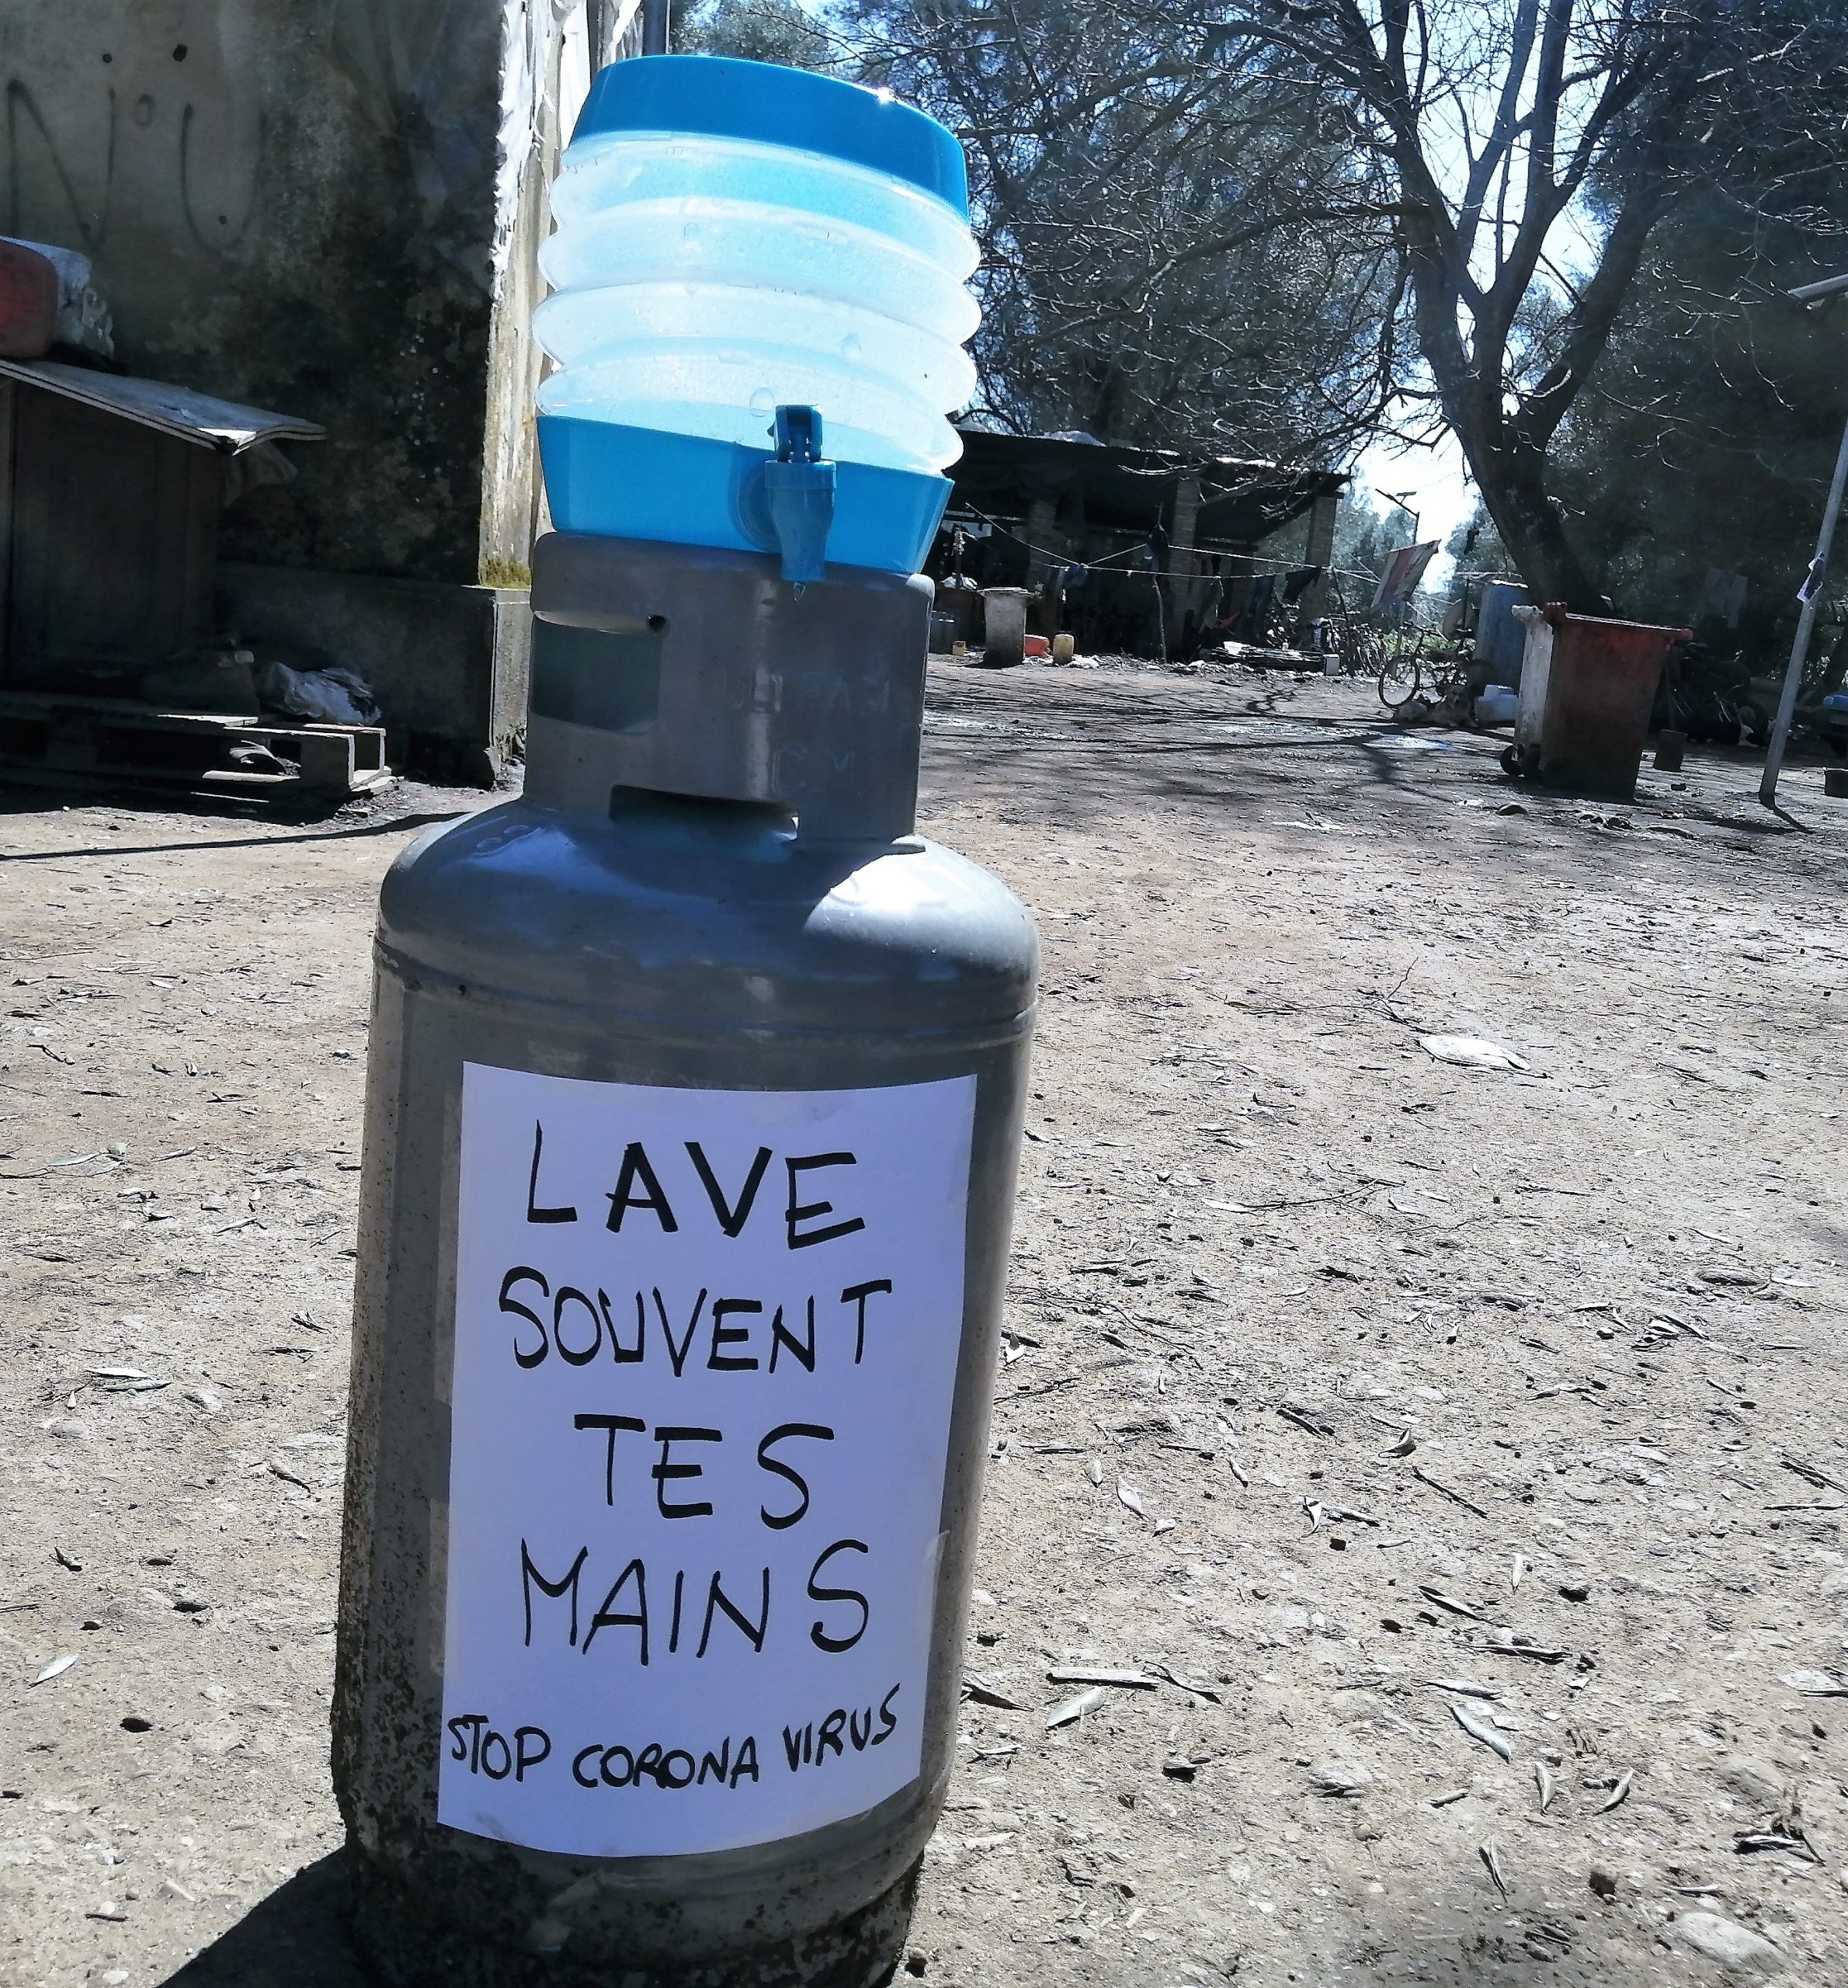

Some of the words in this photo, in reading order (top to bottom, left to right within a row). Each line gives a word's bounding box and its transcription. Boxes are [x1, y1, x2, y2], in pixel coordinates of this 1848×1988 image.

[527, 1120, 865, 1250] LAVE
[498, 1267, 892, 1377] SOUVENT
[574, 1413, 835, 1530] TES
[521, 1538, 869, 1666] MAINS
[448, 1714, 552, 1782] STOP
[572, 1736, 759, 1790] CORONA
[782, 1683, 901, 1773] VIRUS
